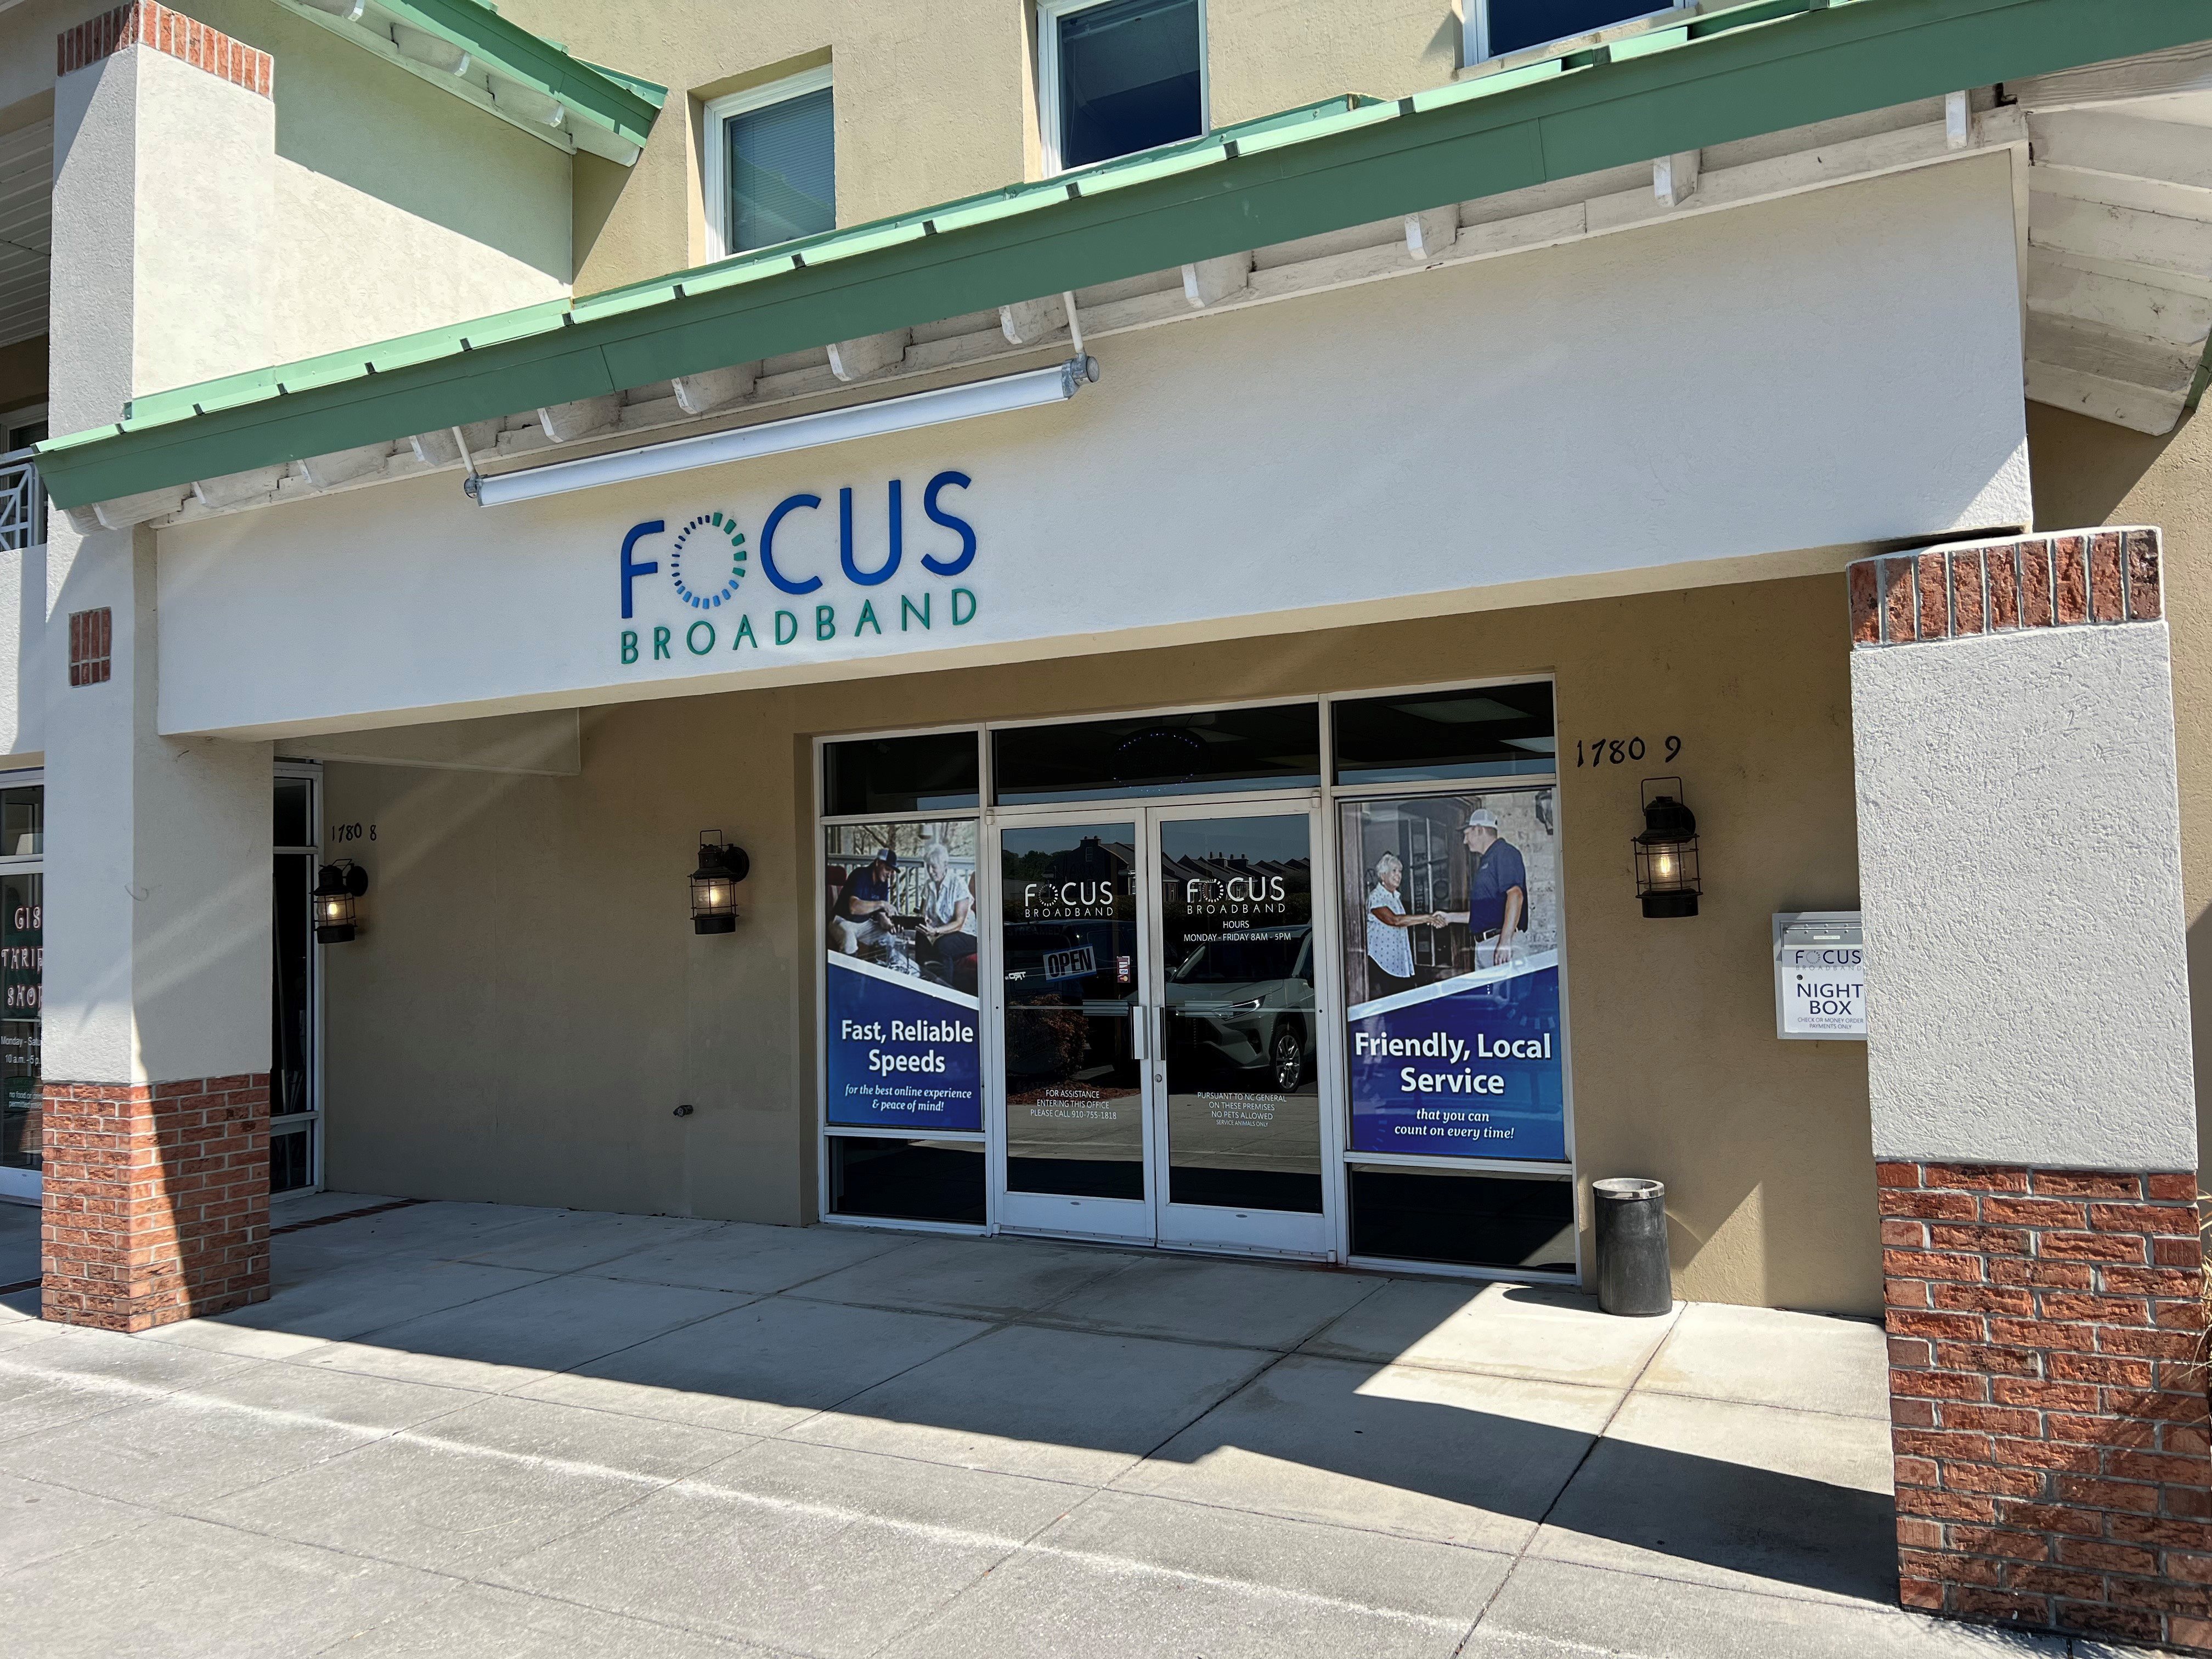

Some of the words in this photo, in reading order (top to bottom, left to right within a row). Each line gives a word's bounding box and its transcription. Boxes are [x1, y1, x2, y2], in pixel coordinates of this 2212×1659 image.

[620, 471, 977, 619] FOCUS
[620, 588, 977, 664] BROADBAND
[1025, 881, 1113, 907] FOCUS
[1187, 876, 1285, 903] FOCUS
[1025, 907, 1113, 918] BROADBAND
[1187, 903, 1285, 915] BROADBAND
[1223, 920, 1250, 928] HOURS
[1183, 933, 1217, 942] MONDAY
[1223, 933, 1249, 941] FRIDAY
[1251, 933, 1268, 941] 8AM
[1274, 932, 1291, 941] 5PM
[1, 948, 43, 972] THRIF
[1047, 948, 1093, 978] OPEN
[1796, 950, 1861, 964] FOCUS
[1797, 983, 1863, 998] NIGHT
[1809, 1000, 1852, 1015] BOX
[842, 1019, 887, 1043] Fast,
[891, 1019, 974, 1042] Reliable
[1, 1036, 23, 1047] Monday
[1355, 1031, 1470, 1064] Friendly,
[1477, 1032, 1551, 1059] Local
[5, 1054, 12, 1063] 10
[868, 1048, 946, 1077] Speeds
[1400, 1066, 1505, 1094] Service
[845, 1084, 858, 1097] for
[859, 1085, 874, 1095] the
[876, 1085, 893, 1096] best
[895, 1086, 922, 1097] online
[924, 1087, 972, 1099] experience
[1046, 1089, 1059, 1097] FOR
[1060, 1090, 1100, 1099] ASSISTANCE
[1197, 1092, 1233, 1100] PURSUANT
[1256, 1094, 1287, 1102] GENERAL
[872, 1099, 879, 1108] &
[881, 1101, 906, 1111] peace
[907, 1100, 917, 1113] of
[918, 1101, 944, 1111] mind!
[1037, 1099, 1069, 1108] ENTERING
[1070, 1100, 1085, 1108] THIS
[1086, 1101, 1110, 1109] OFFICE
[1243, 1103, 1275, 1111] PREMISES
[1030, 1109, 1053, 1117] PLEASE
[1054, 1109, 1071, 1118] CALL
[1071, 1110, 1118, 1120] 910-755-1818
[1240, 1112, 1273, 1120] ALLOWED
[1417, 1108, 1440, 1120] that
[1443, 1111, 1466, 1124] you
[1468, 1111, 1490, 1122] can
[1394, 1125, 1427, 1136] count
[1430, 1127, 1445, 1137] on
[1447, 1127, 1480, 1141] every
[1483, 1126, 1515, 1139] time!
